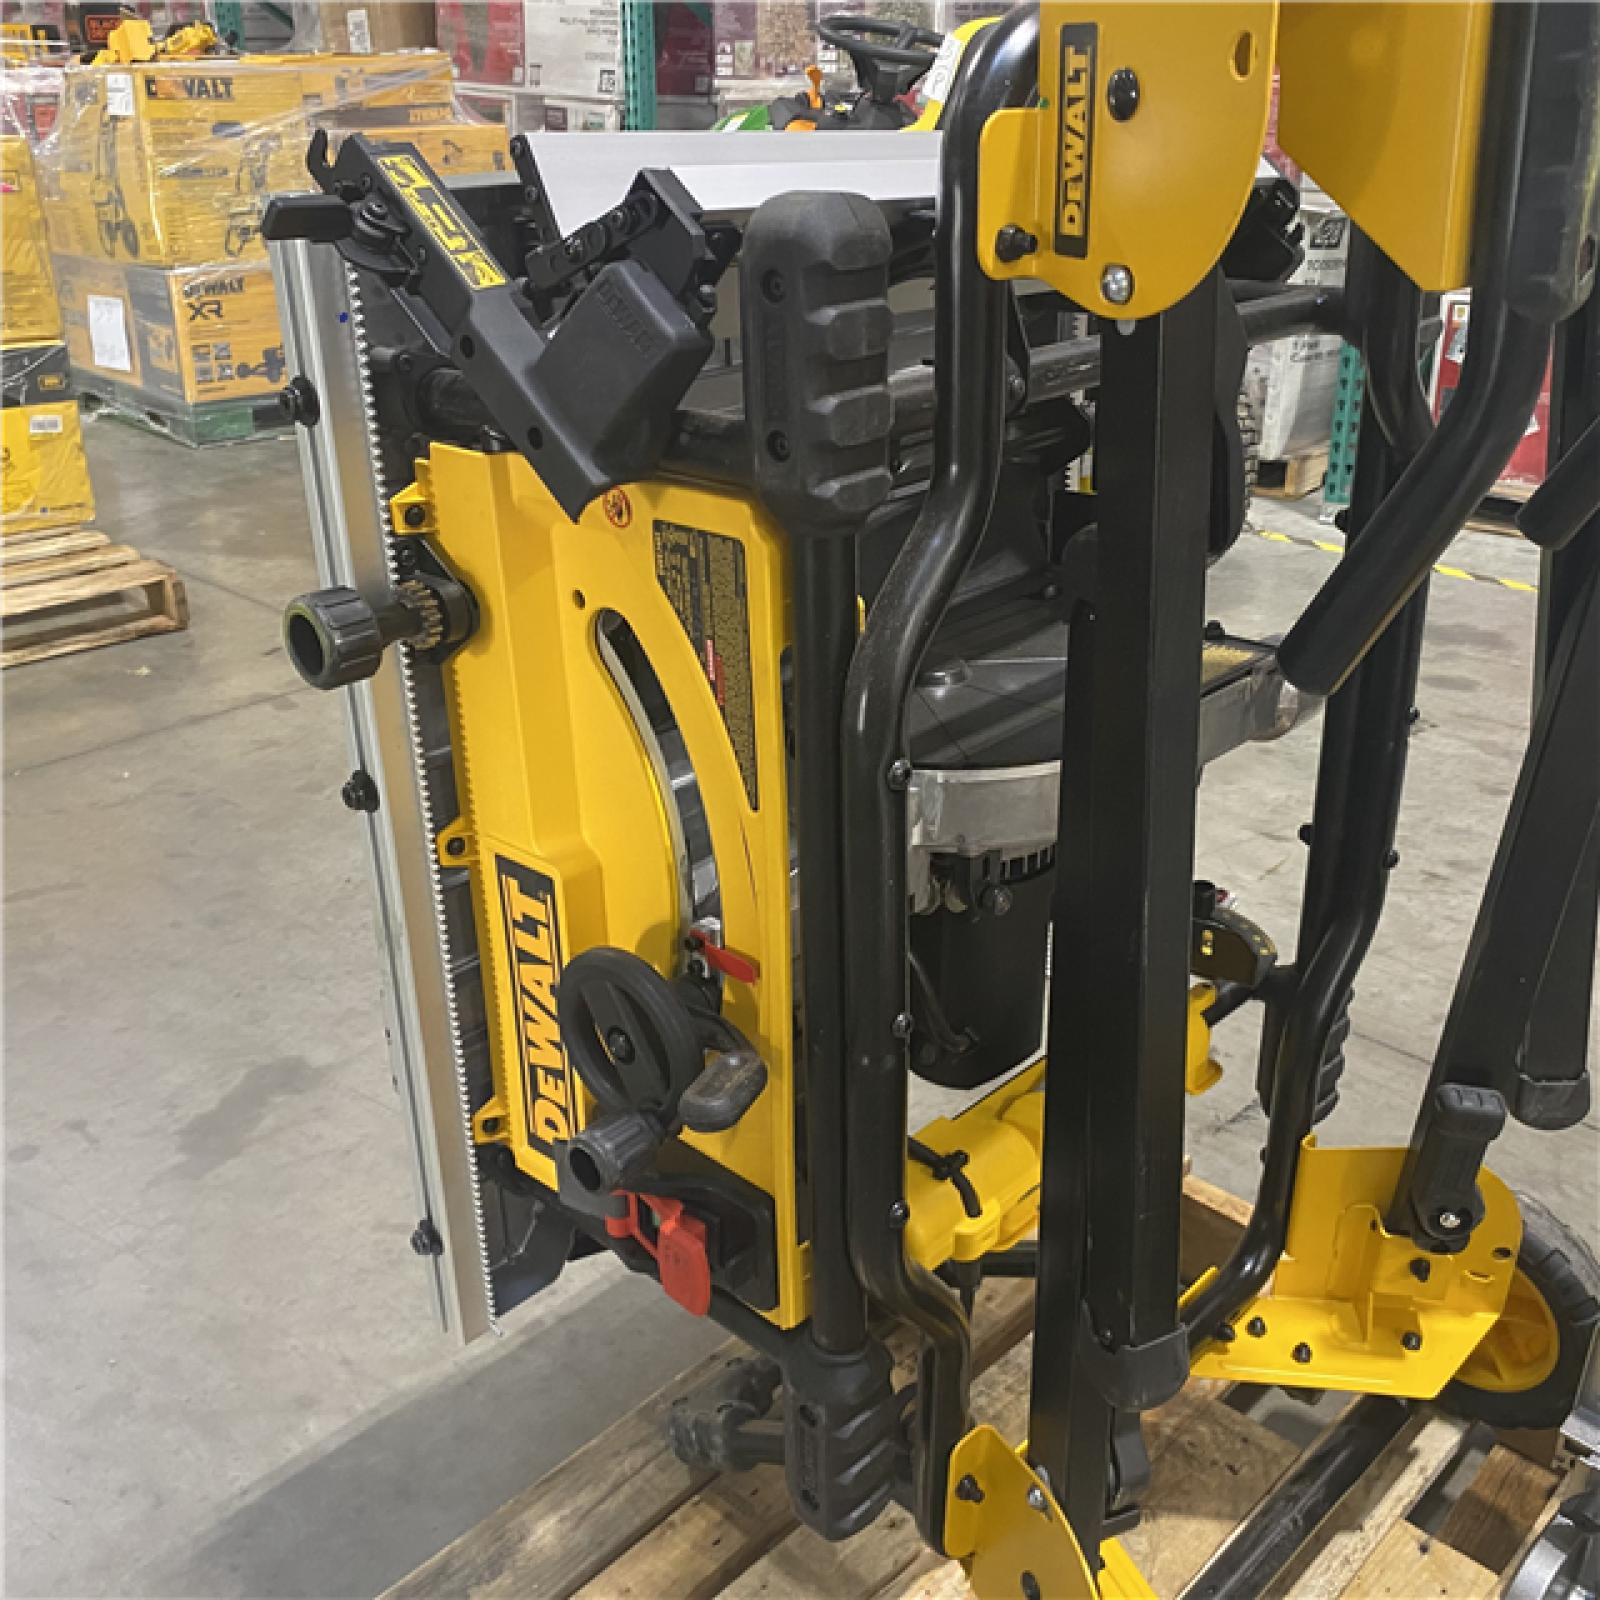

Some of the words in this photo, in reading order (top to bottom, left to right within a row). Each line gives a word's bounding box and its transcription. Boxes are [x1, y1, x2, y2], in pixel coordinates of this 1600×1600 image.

[1062, 45, 1089, 236] DEWALT
[187, 300, 223, 321] XR
[507, 874, 571, 1145] DEWALT
